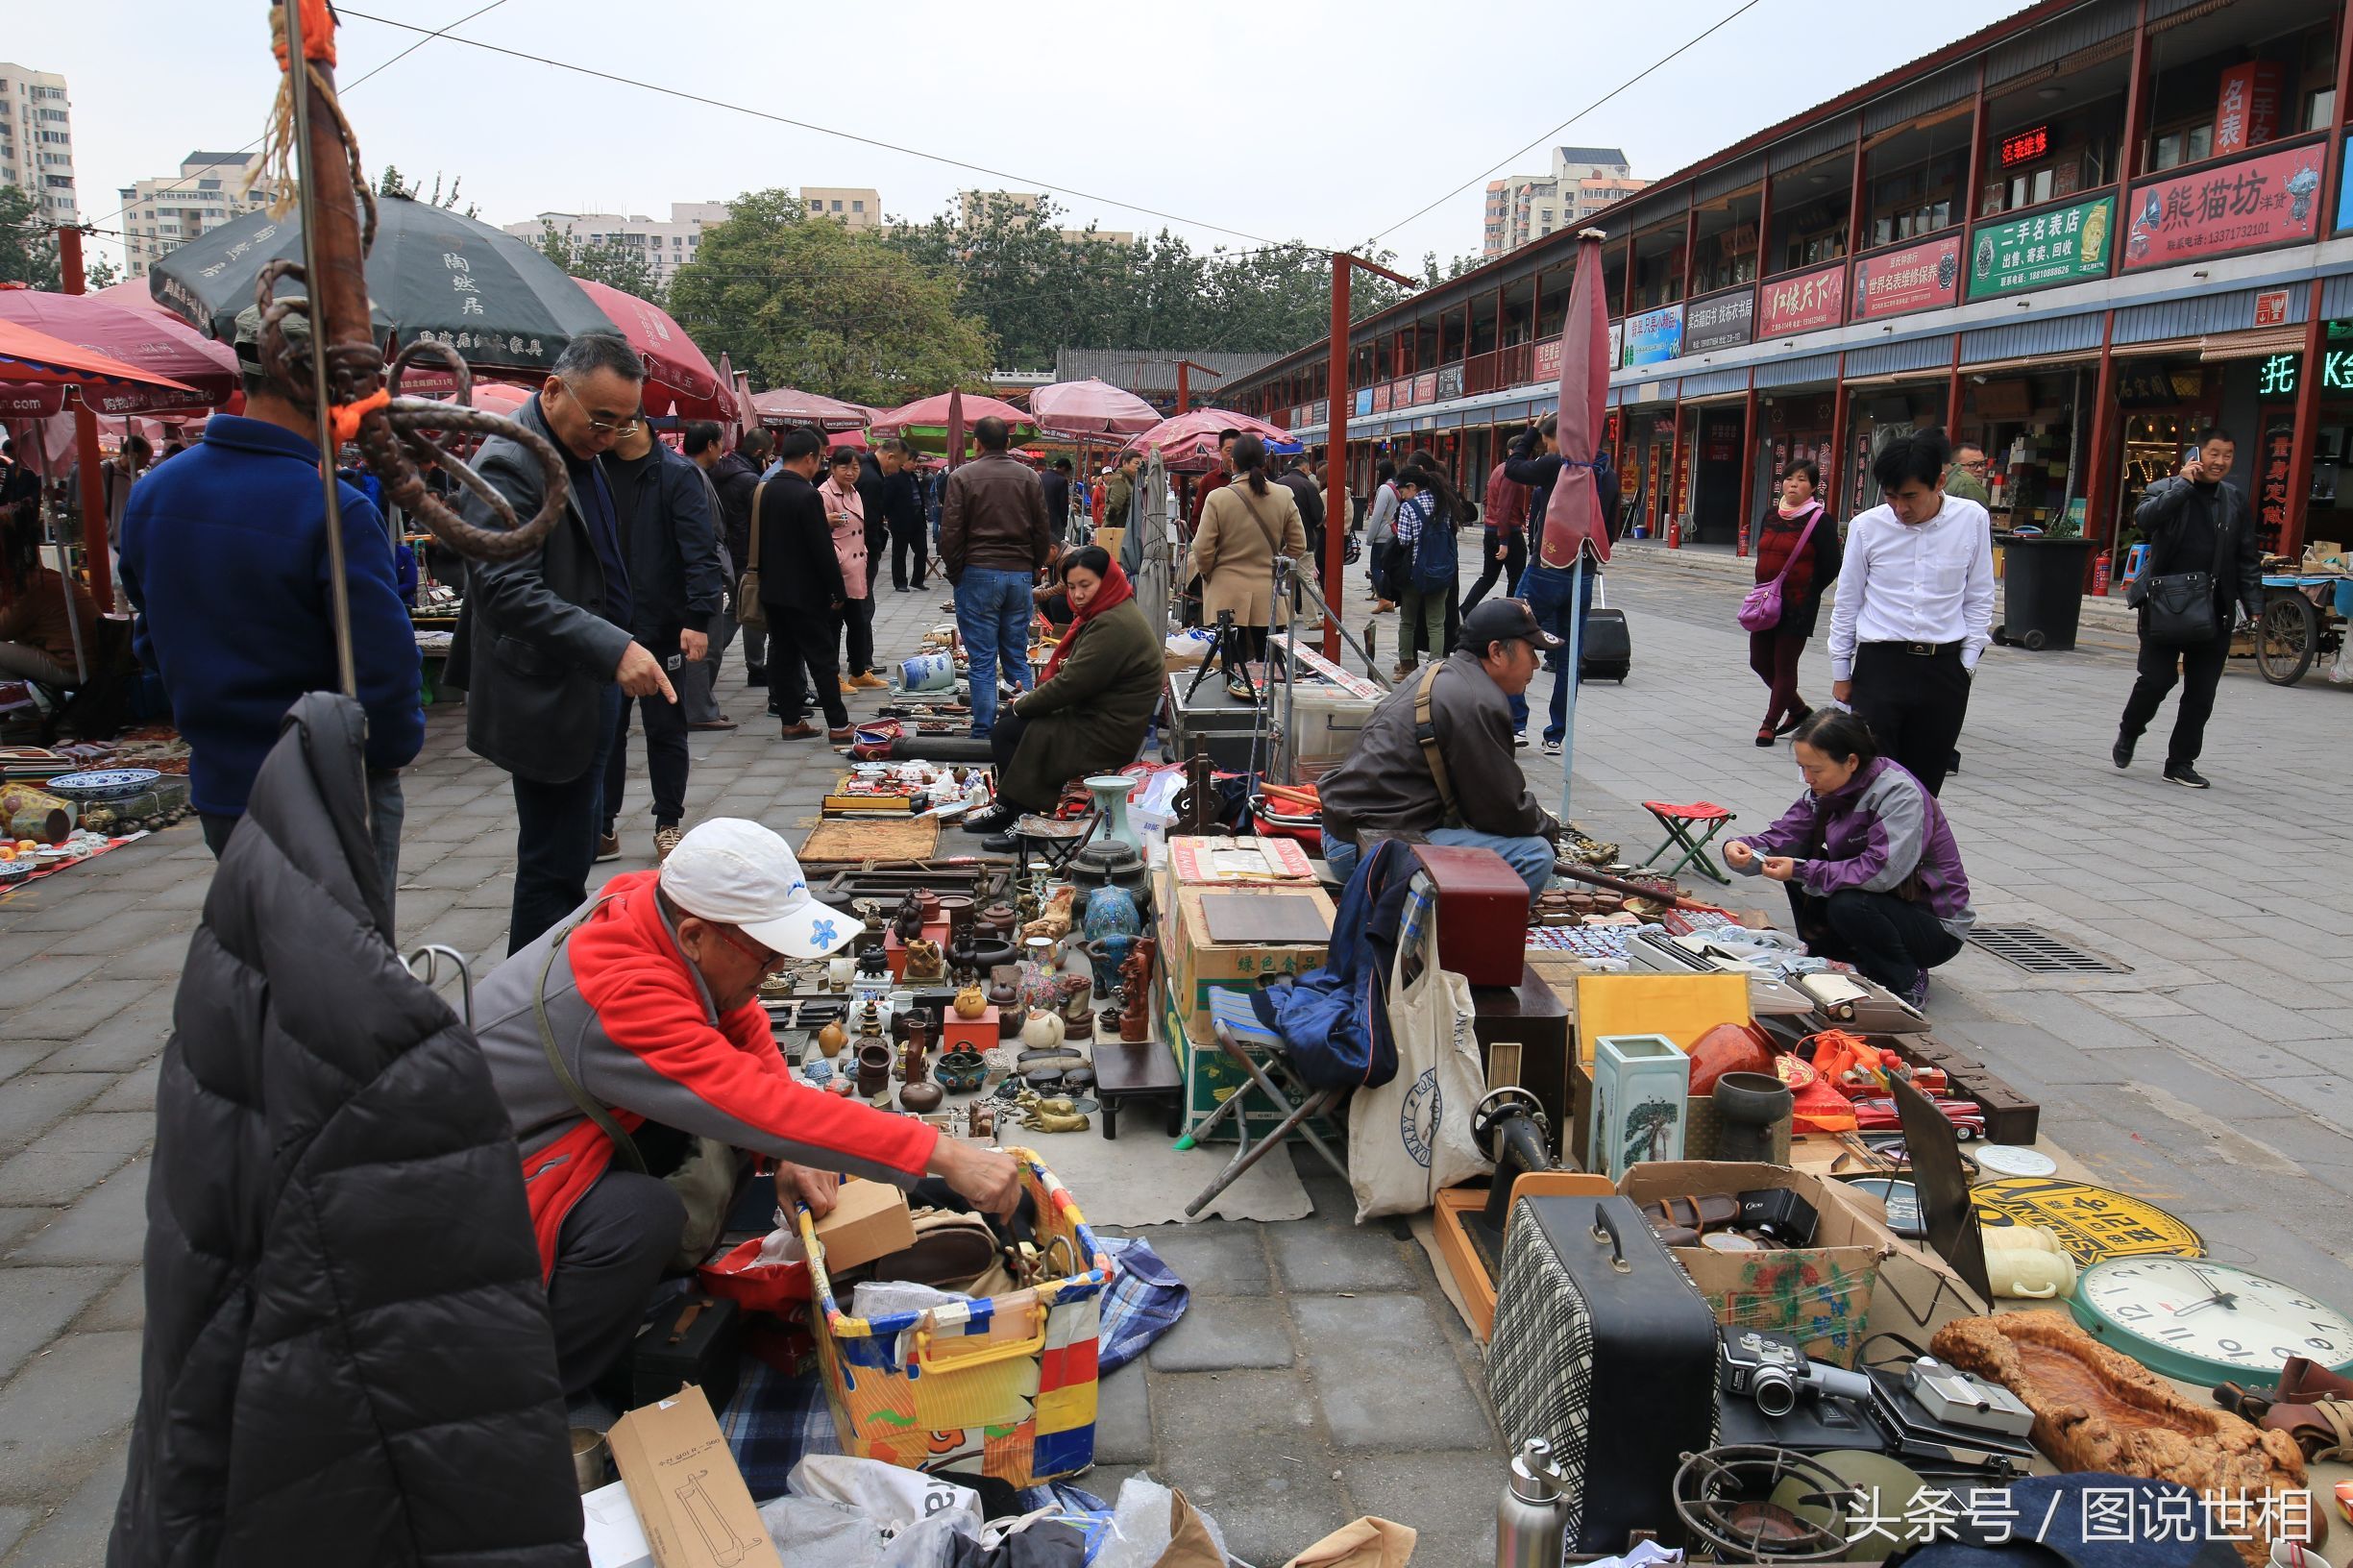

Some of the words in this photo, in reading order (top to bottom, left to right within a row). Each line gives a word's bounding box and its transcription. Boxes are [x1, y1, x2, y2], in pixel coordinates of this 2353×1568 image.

[2218, 80, 2244, 154] 名表
[2002, 133, 2047, 162] 名表维修
[2164, 169, 2267, 233] 熊猫坊
[2260, 192, 2288, 210] 洋货
[2001, 208, 2080, 247] 二手名表店
[2001, 239, 2072, 269] 出售、寄卖、回收
[443, 252, 483, 315] 陶然居
[1869, 263, 1938, 295] 世界名表维修保养
[1772, 275, 1829, 320] 红缘天下
[1238, 955, 1316, 972] 绿色食品
[1997, 1200, 2099, 1251] SOCONY
[2112, 1269, 2142, 1279] 2
[2148, 1262, 2172, 1271] 3
[2243, 1280, 2272, 1289] 5
[2117, 1304, 2153, 1321] 12
[2288, 1300, 2316, 1311] 6
[2160, 1327, 2195, 1341] 11
[2307, 1320, 2341, 1333] 7
[2218, 1338, 2255, 1358] 10
[2304, 1337, 2335, 1351] 8
